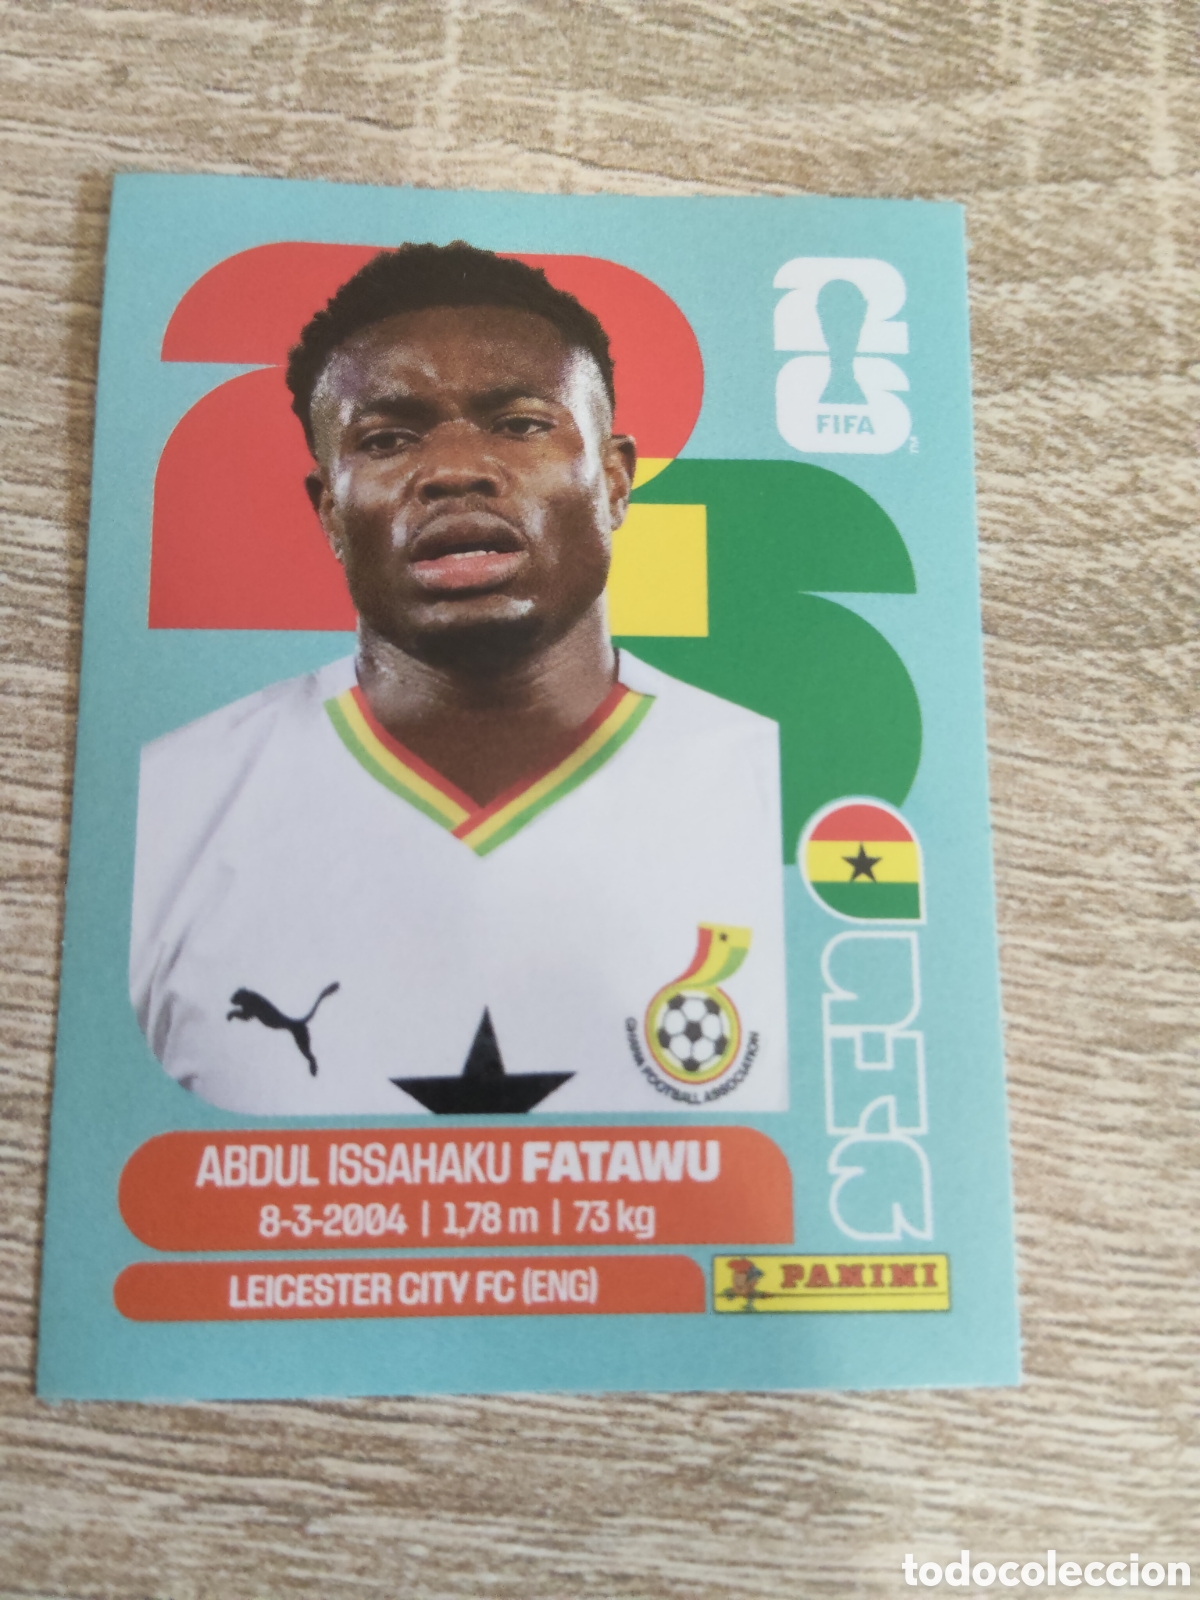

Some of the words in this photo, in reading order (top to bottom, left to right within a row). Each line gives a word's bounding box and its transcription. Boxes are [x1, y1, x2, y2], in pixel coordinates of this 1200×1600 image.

[816, 414, 875, 435] FIFA
[195, 1144, 320, 1188] ABDUL
[328, 1141, 511, 1186] ISSAHAKU
[521, 1140, 720, 1184] FATAWU
[259, 1202, 408, 1238] 8-3-2004
[443, 1201, 501, 1239] 1,78
[508, 1206, 539, 1235] m
[573, 1199, 611, 1233] 73
[616, 1198, 656, 1240] kg
[229, 1272, 392, 1309] LEICESTER
[398, 1270, 469, 1306] CITY
[475, 1269, 515, 1304] FC
[521, 1267, 599, 1305] (ENG)
[780, 1263, 938, 1289] PANINI
